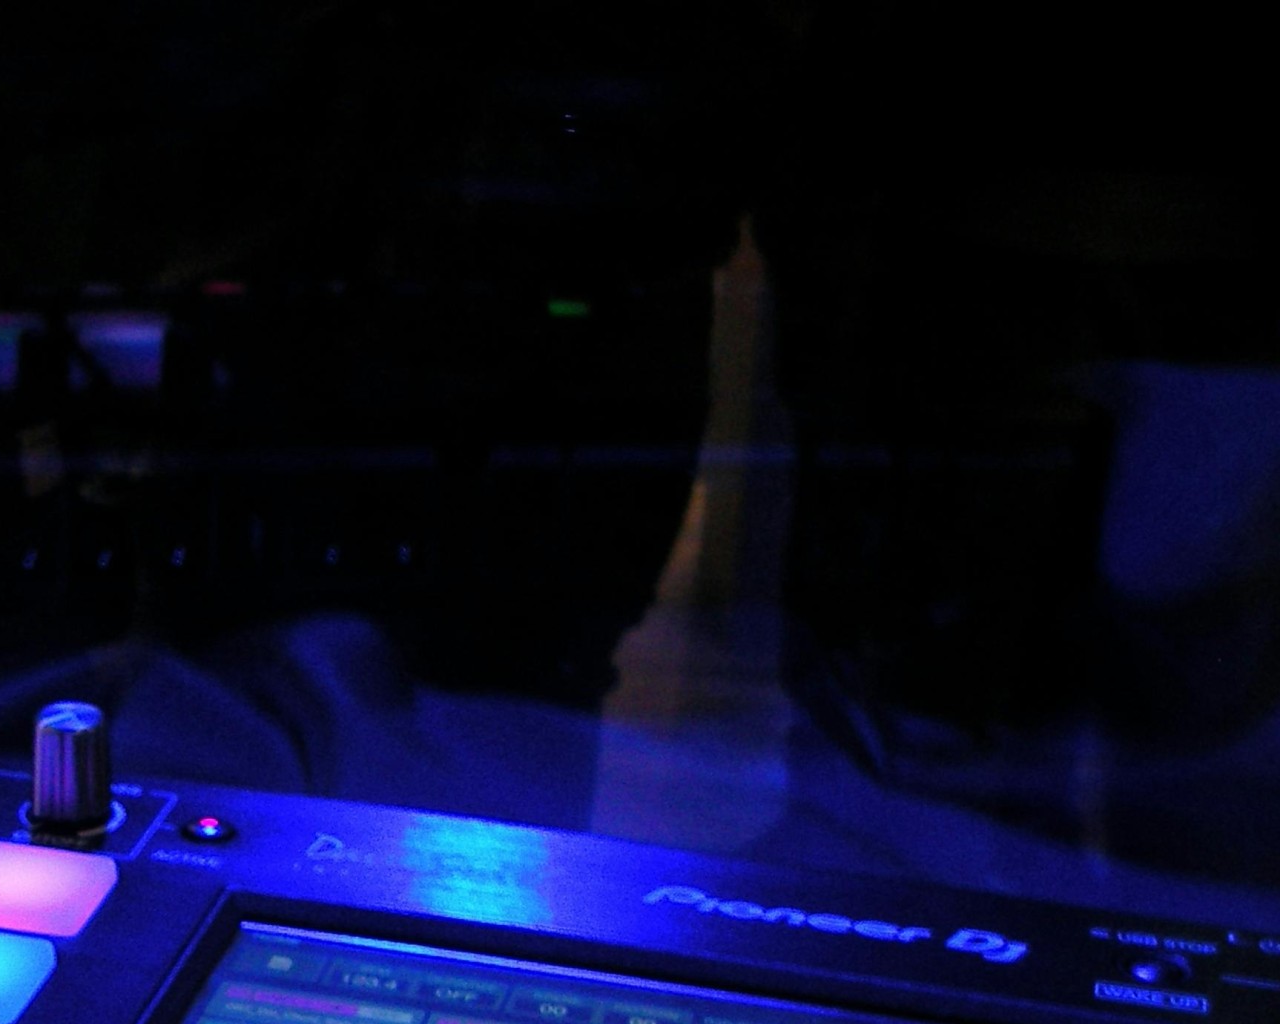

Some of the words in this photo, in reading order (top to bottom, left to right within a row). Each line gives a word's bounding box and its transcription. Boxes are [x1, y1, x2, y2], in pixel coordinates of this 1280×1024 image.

[642, 885, 932, 944] Pioneer
[1102, 983, 1164, 1004] WAKE
[1169, 994, 1203, 1011] UP
